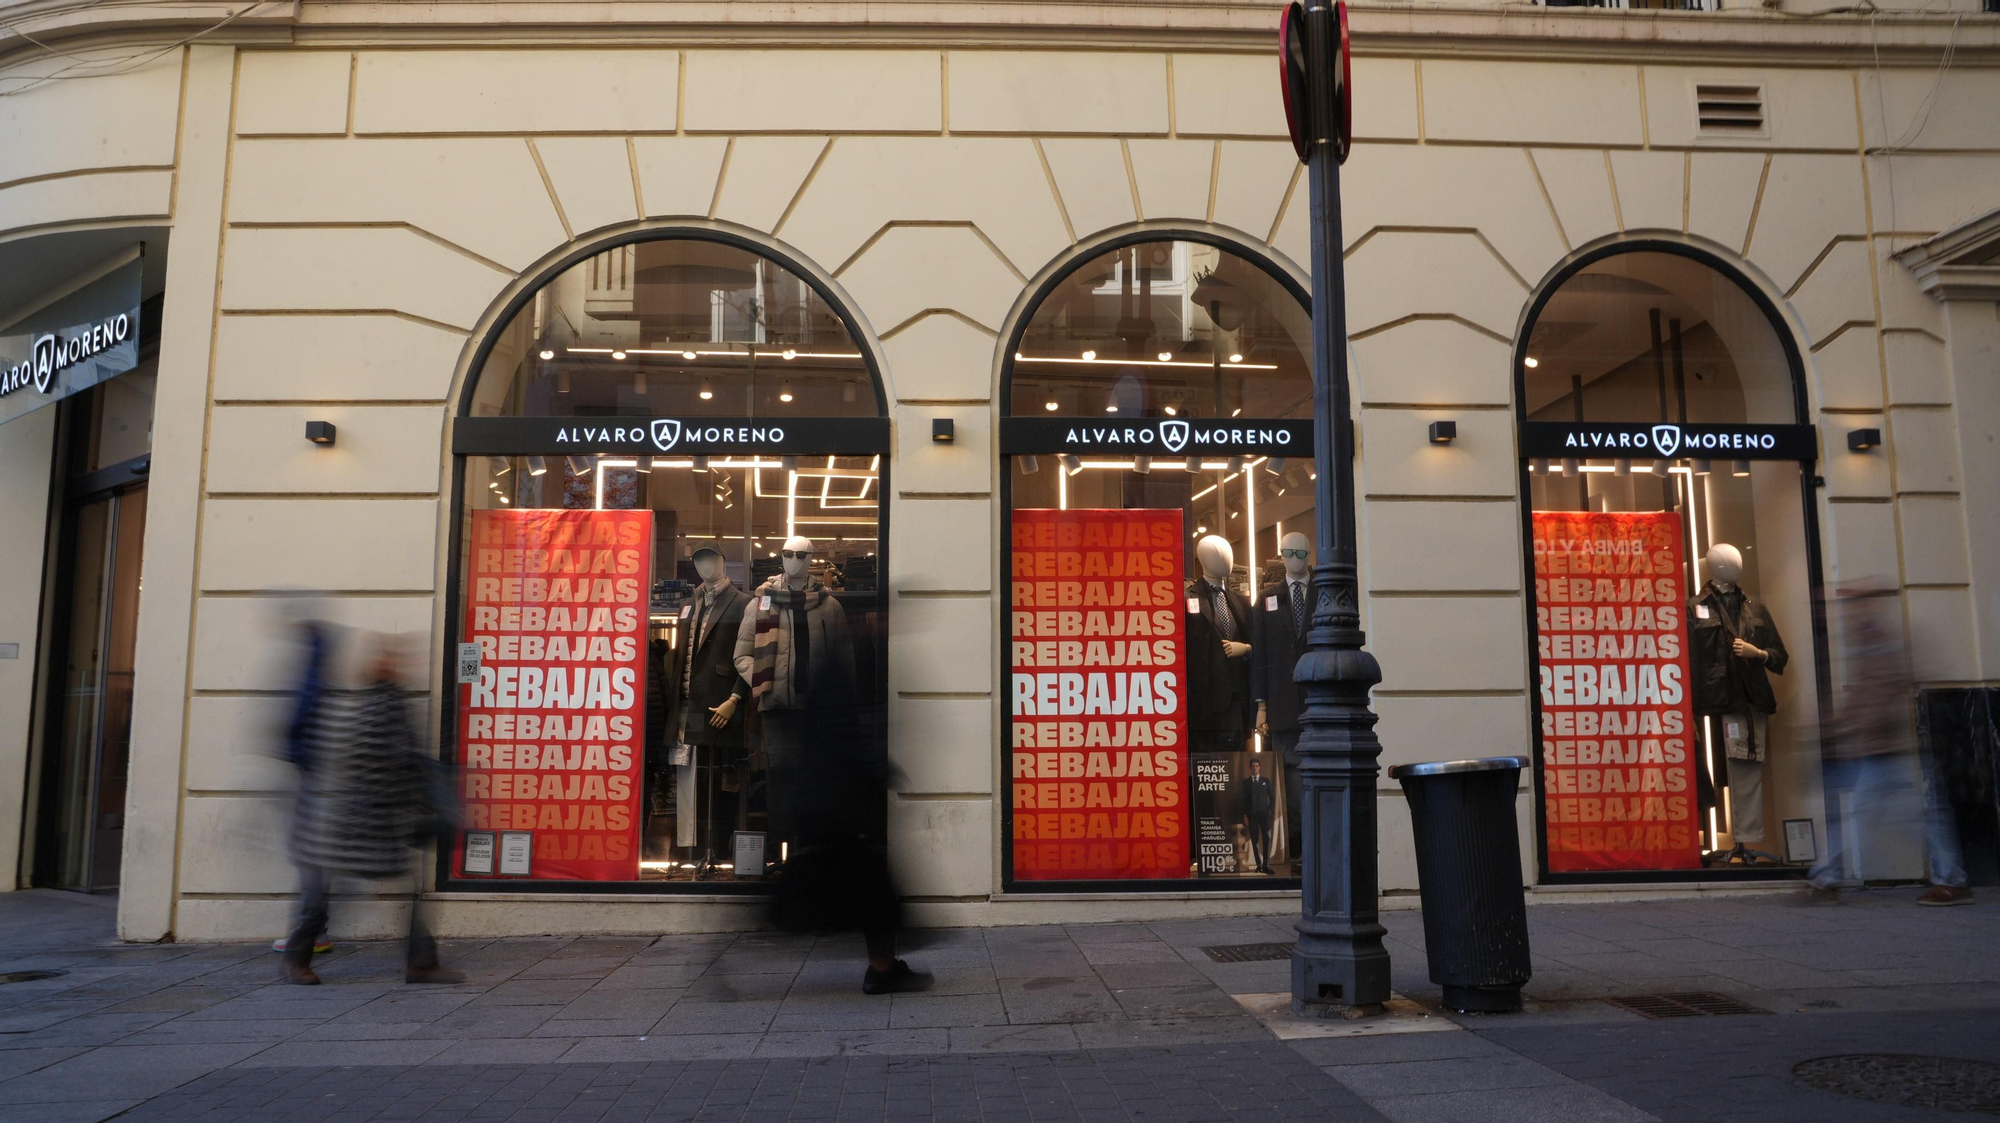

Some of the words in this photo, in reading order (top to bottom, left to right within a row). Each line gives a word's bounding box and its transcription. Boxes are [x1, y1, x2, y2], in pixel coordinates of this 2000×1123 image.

[1, 360, 31, 395] ARO
[56, 313, 128, 370] MORENO
[556, 428, 645, 443] ALVARO
[685, 428, 785, 443] MORENO
[1066, 428, 1154, 443] ALVARO
[1195, 429, 1291, 444] MORENO
[1566, 432, 1648, 448] ALVARO
[1685, 433, 1775, 449] MORENO
[480, 520, 641, 545] REBAJAS
[1012, 522, 1173, 547] REBAJAS
[477, 549, 639, 574] REBAJAS
[1012, 551, 1174, 577] REBAJAS
[476, 577, 639, 603] REBAJAS
[1012, 581, 1175, 606] REBAJAS
[1536, 578, 1676, 603] REBAJAS
[474, 606, 637, 632] REBAJAS
[1012, 610, 1176, 636] REBAJAS
[1537, 606, 1678, 631] REBAJAS
[473, 635, 636, 661] REBAJAS
[1012, 640, 1176, 666] REBAJAS
[1538, 634, 1680, 660] REBAJAS
[470, 666, 635, 710] REBAJAS
[1012, 671, 1177, 715] REBAJAS
[1540, 663, 1682, 706] REBAJAS
[468, 714, 632, 741] REBAJAS
[1012, 720, 1177, 748] REBAJAS
[1542, 710, 1684, 736] REBAJAS
[466, 744, 632, 770] REBAJAS
[1013, 751, 1178, 778] REBAJAS
[1543, 739, 1685, 765] REBAJAS
[1197, 765, 1226, 773] PACK
[1197, 774, 1229, 782] TRAJE
[1544, 767, 1687, 794] REBAJAS
[466, 774, 631, 800] REBAJAS
[1013, 781, 1179, 808] REBAJAS
[1198, 783, 1225, 791] ARTE
[464, 804, 630, 831] REBAJAS
[1546, 796, 1688, 823] REBAJAS
[1013, 812, 1179, 839] REBAJAS
[1013, 842, 1180, 870] REBAJAS
[1203, 845, 1231, 853] TODO
